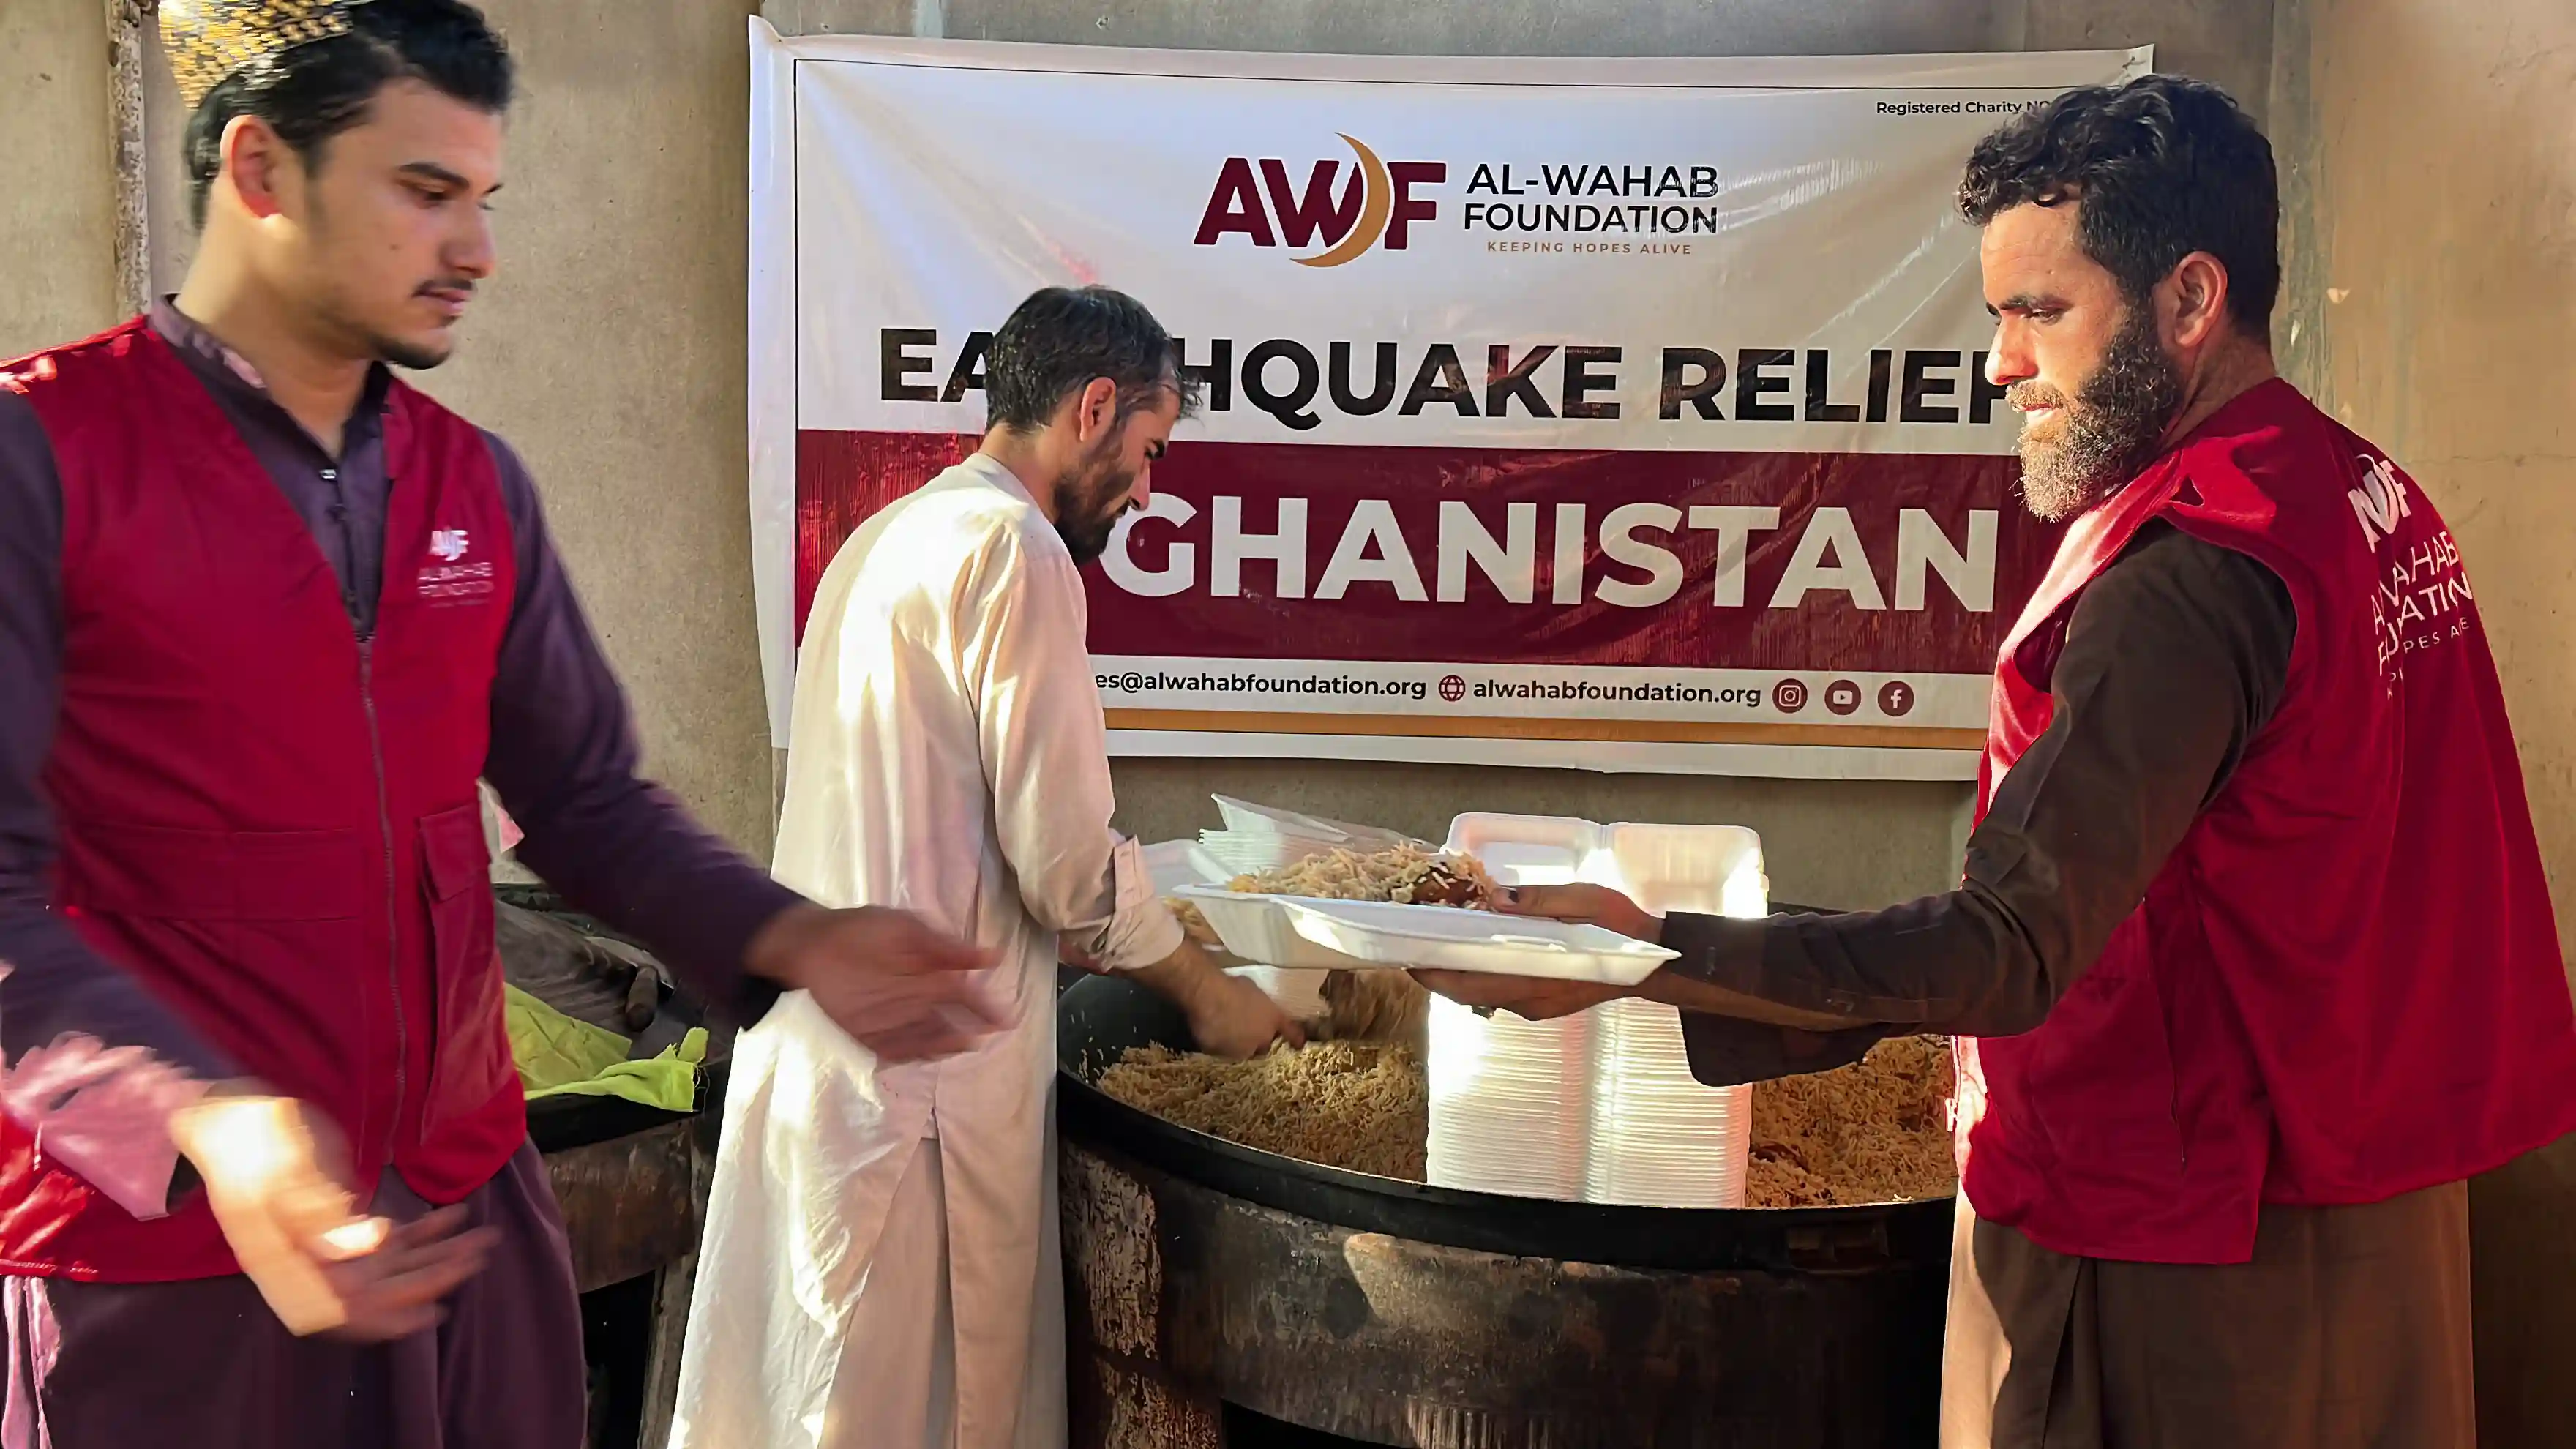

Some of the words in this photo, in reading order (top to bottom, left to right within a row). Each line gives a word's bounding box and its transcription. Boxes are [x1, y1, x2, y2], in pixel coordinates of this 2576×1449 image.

[1876, 101, 1961, 116] Registered
[1965, 100, 2022, 113] Charity
[1466, 163, 1719, 198] AL-WAHAB
[1194, 157, 1447, 250] AWF
[1464, 203, 1718, 233] FOUNDATION
[1487, 241, 1564, 253] KEEPING
[1573, 242, 1631, 254] HOPES
[1640, 244, 1692, 255] ALIVE
[881, 328, 1622, 430] EAHQUAKE
[1098, 492, 1999, 612] GHANISTAN
[1095, 671, 1426, 700] es@alwahabfoundation.org
[1473, 680, 1761, 708] alwahabfoundation.org
